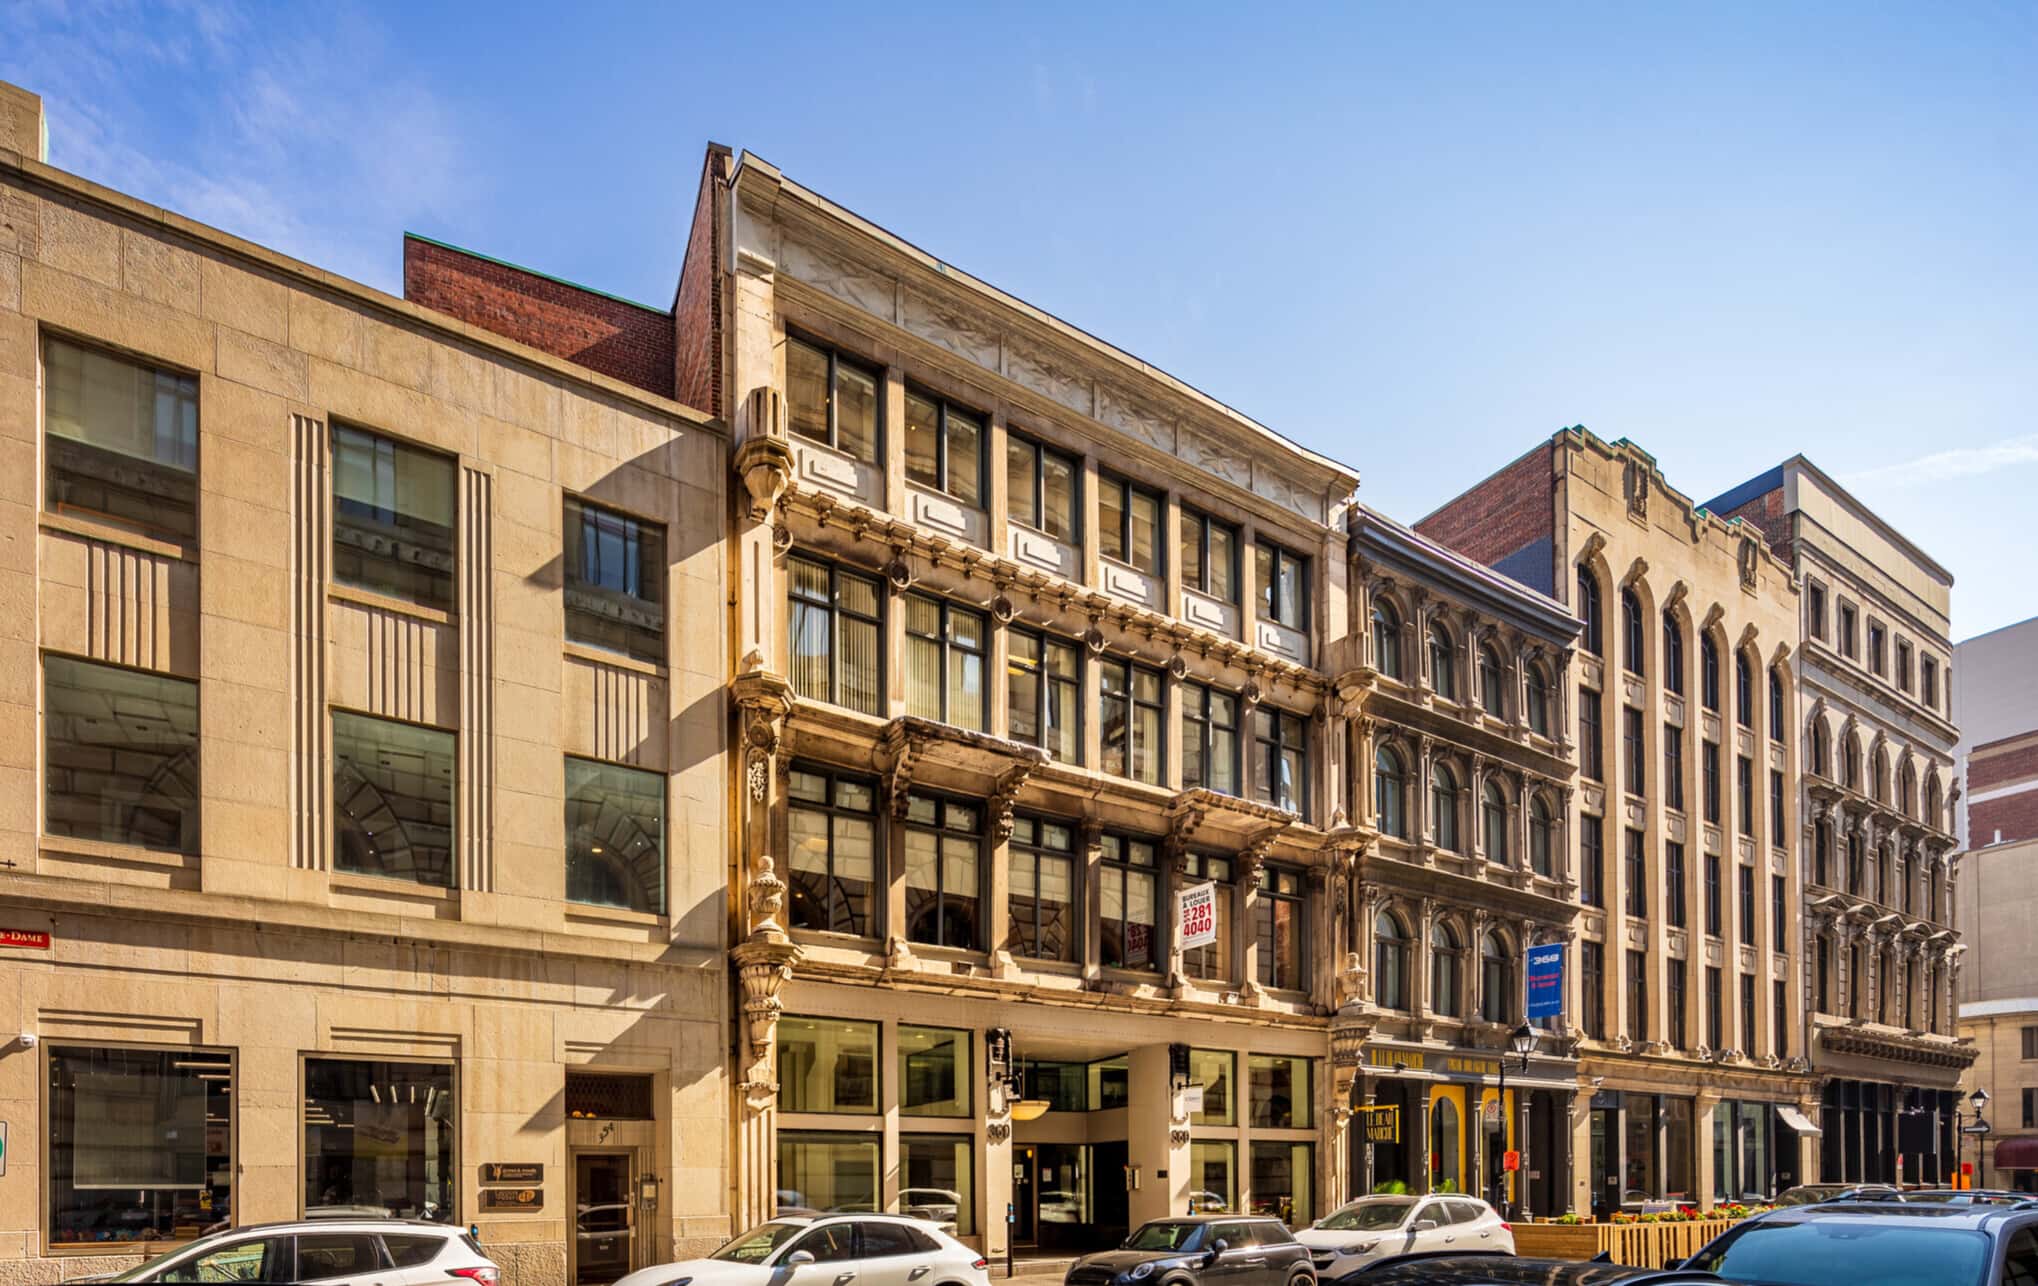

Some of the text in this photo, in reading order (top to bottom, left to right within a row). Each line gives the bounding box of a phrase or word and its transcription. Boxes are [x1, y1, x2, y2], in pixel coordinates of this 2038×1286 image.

[1191, 902, 1212, 921] 281
[1183, 917, 1212, 937] 4040
[986, 1123, 1010, 1140] 360
